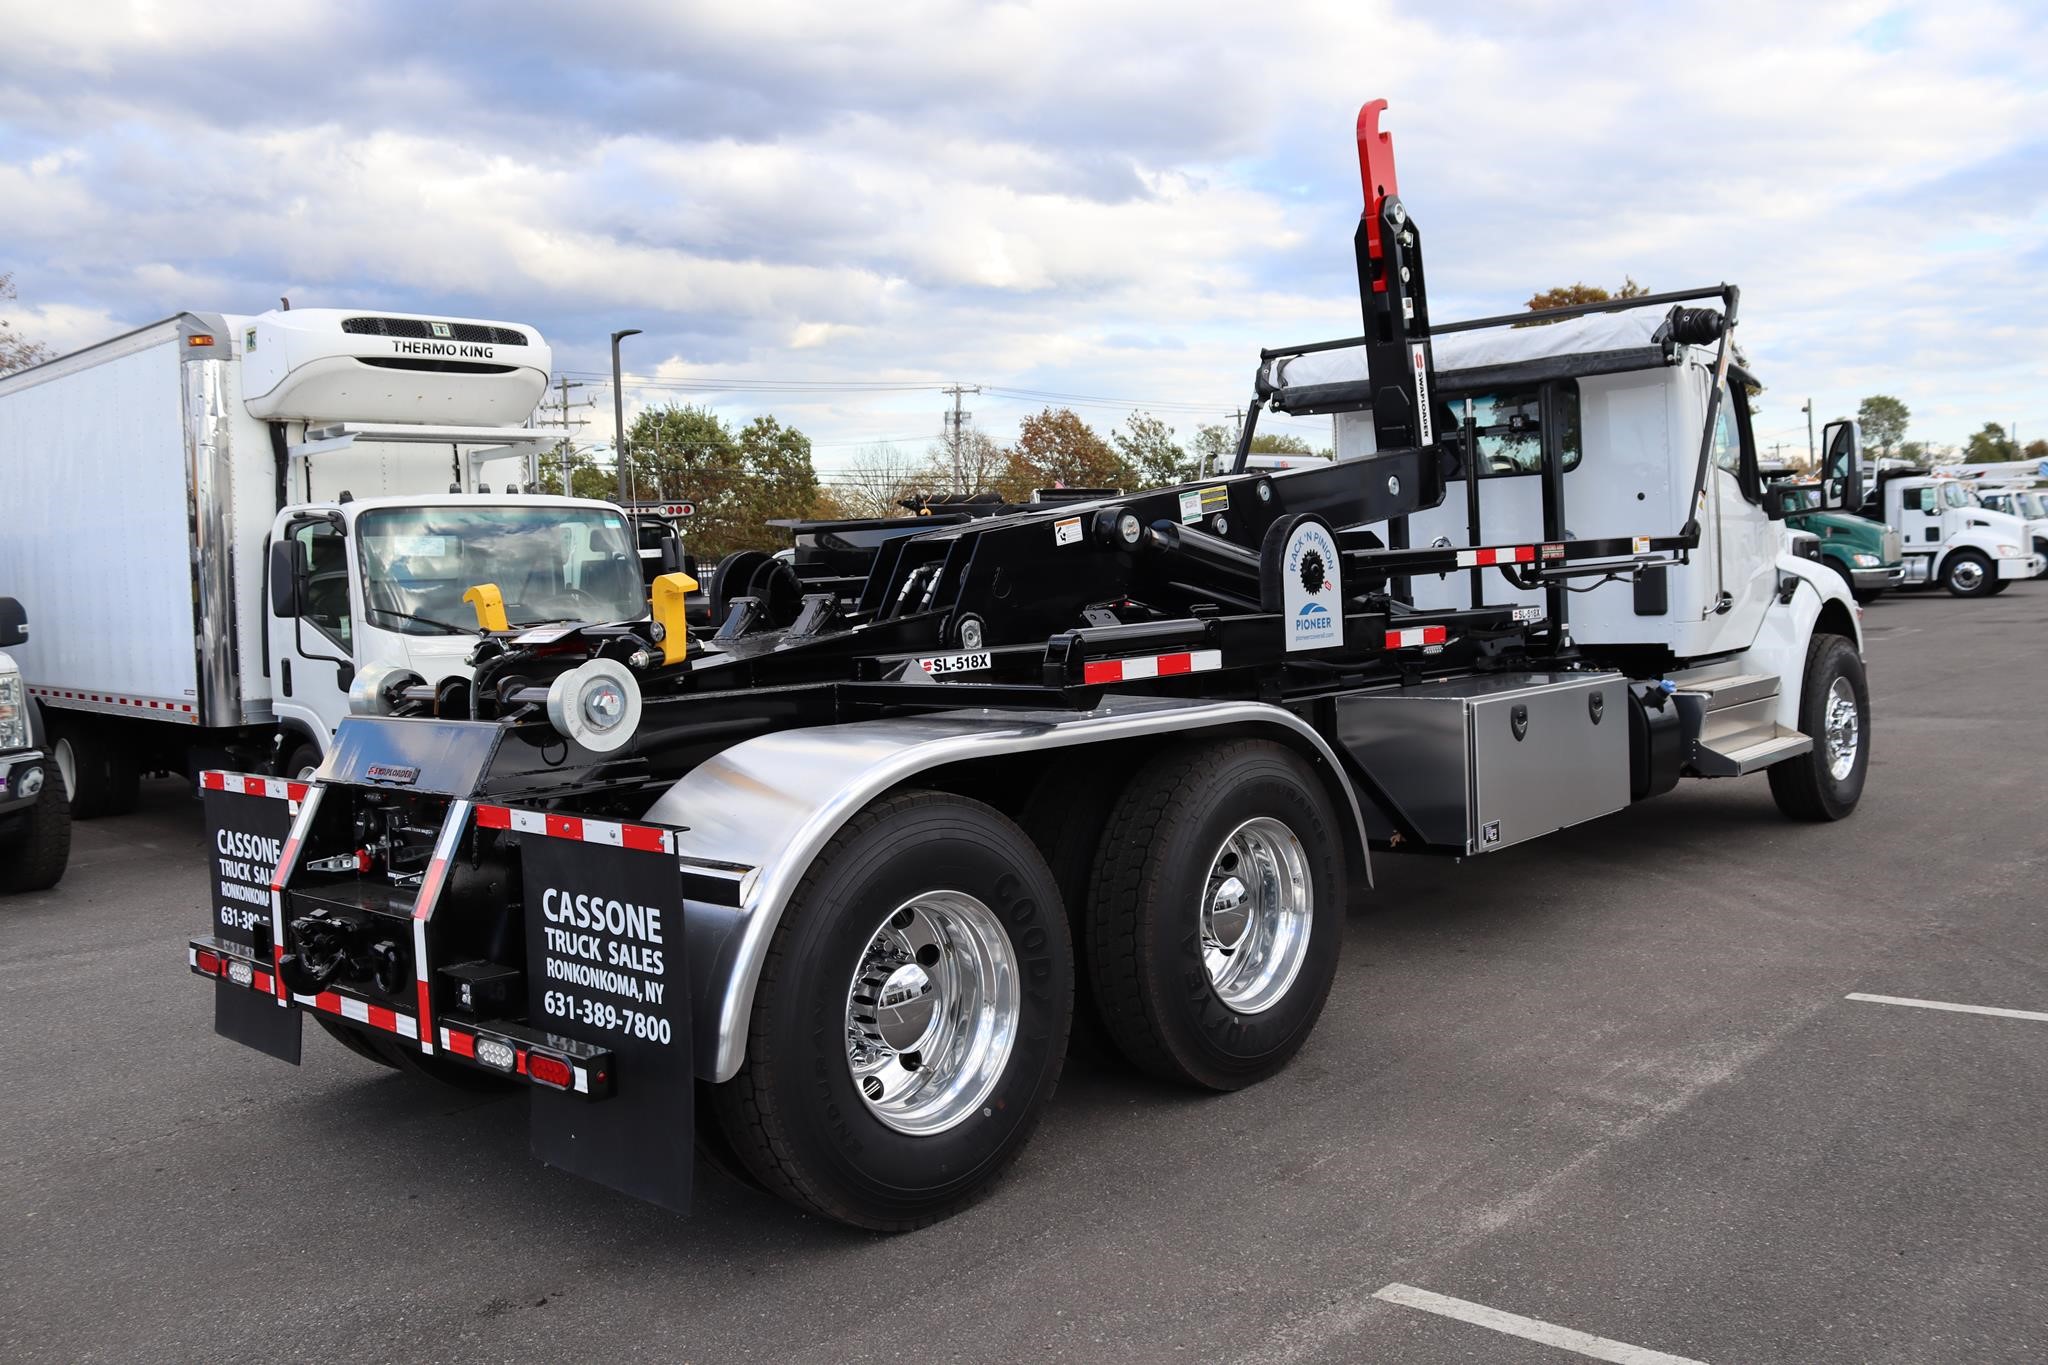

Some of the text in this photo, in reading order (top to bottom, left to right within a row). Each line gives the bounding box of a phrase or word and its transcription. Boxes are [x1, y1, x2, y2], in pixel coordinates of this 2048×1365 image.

[392, 340, 493, 359] THERMO KING
[1417, 371, 1429, 438] SWAPLOADER
[1289, 536, 1305, 573] RACK
[1314, 531, 1334, 571] PINION
[1296, 617, 1332, 631] PIONEER
[934, 653, 988, 673] SL-518X
[217, 829, 280, 864] CASSONE
[219, 858, 275, 887] TRUCK SAL
[221, 906, 270, 932] 631-38
[542, 888, 663, 944] CASSONE
[544, 926, 665, 976] TRUCK SALES
[546, 957, 665, 1005] RONKONKOMA, NY
[544, 990, 671, 1045] 631-389-7800
